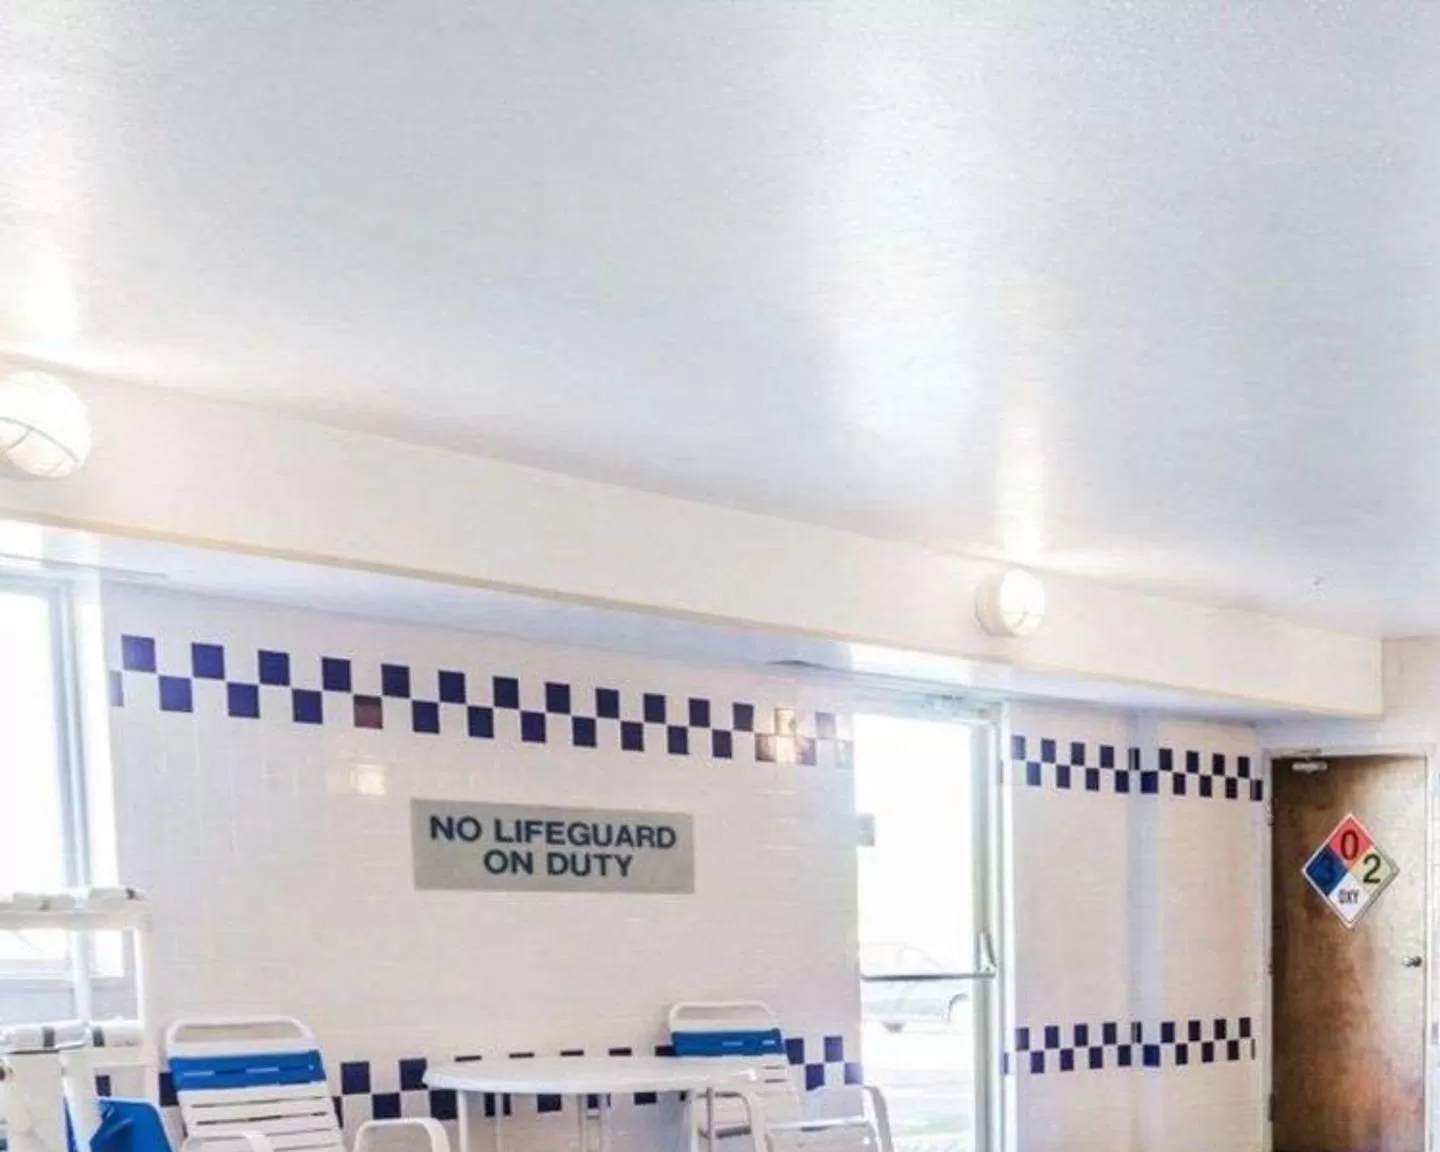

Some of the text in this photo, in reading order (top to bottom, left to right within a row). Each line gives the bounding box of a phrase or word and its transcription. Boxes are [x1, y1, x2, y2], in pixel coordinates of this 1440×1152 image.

[429, 815, 676, 849] NO LIFEGUARD
[1341, 829, 1358, 860] 0
[483, 850, 633, 877] ON DUTY
[1362, 853, 1381, 883] 2
